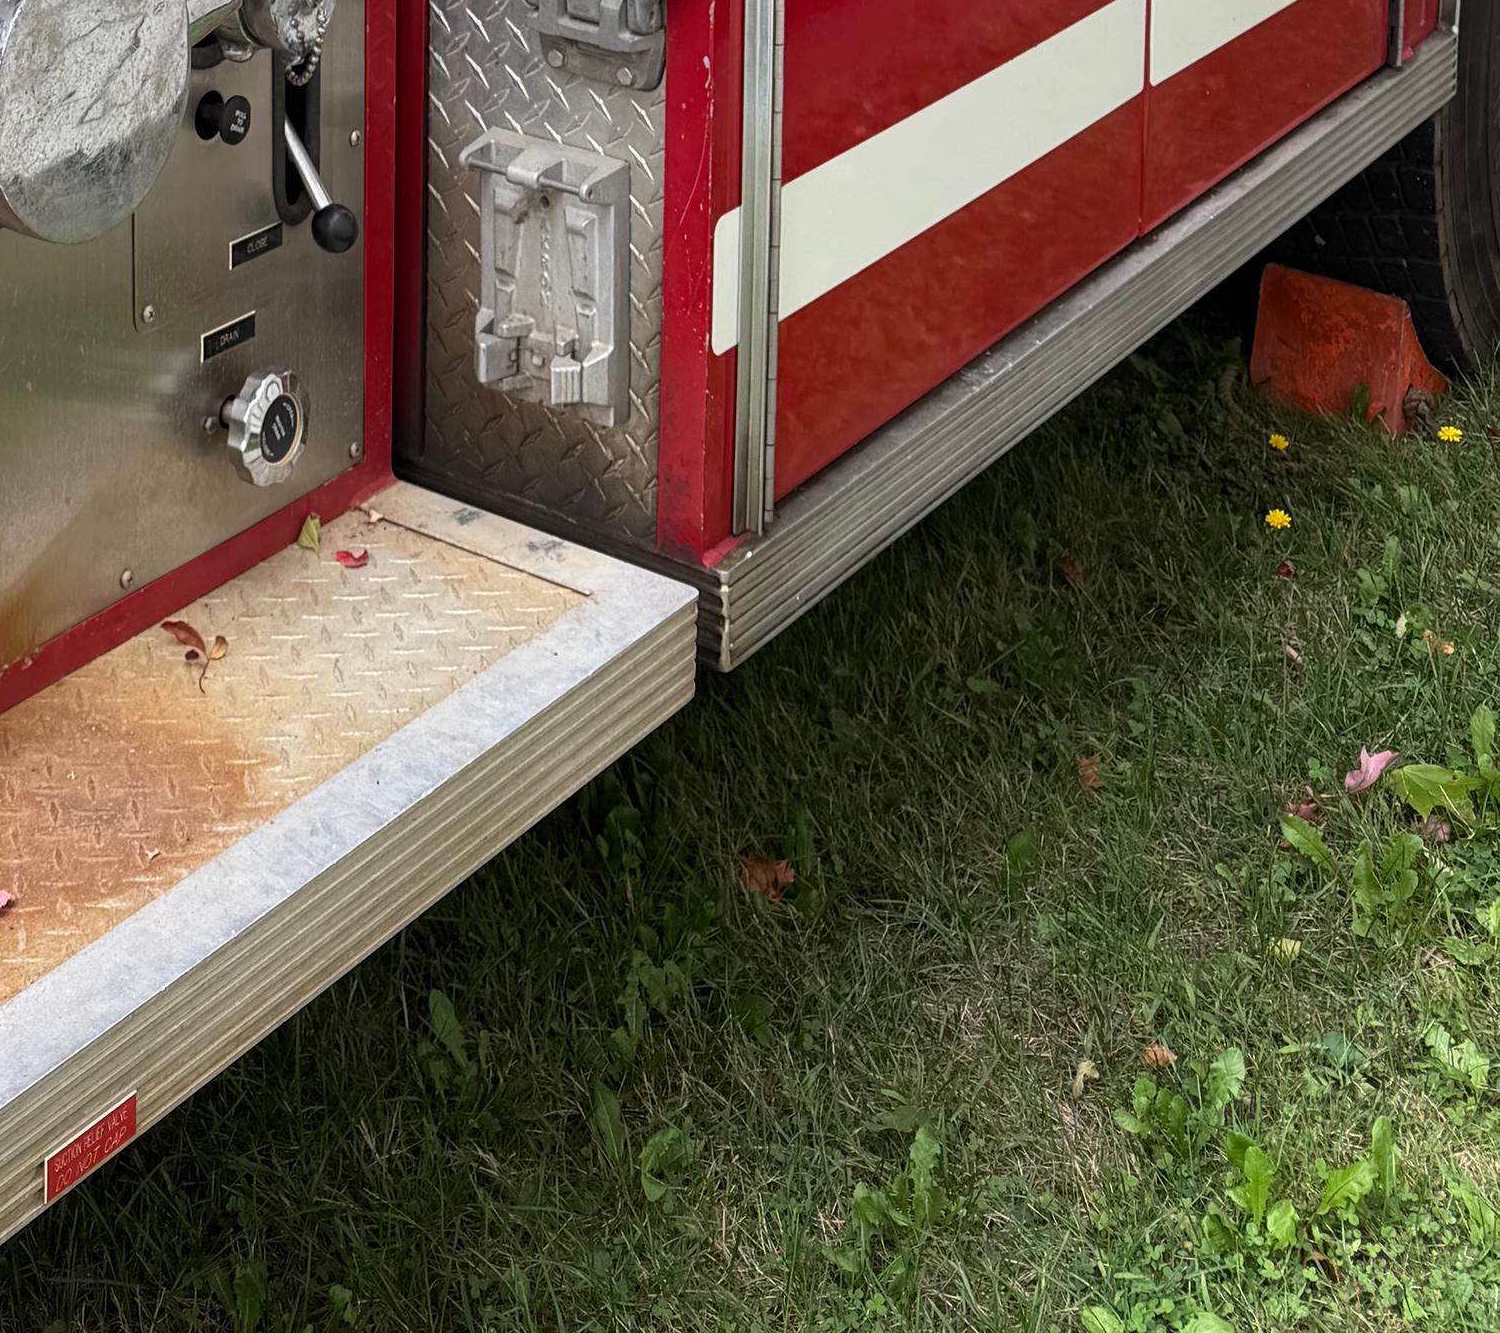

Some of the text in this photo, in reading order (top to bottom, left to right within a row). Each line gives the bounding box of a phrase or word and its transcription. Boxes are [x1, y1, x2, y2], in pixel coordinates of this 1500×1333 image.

[247, 236, 268, 254] CLOSE
[55, 1105, 128, 1172] SUCTION RELIEF VALVE
[56, 1126, 126, 1192] DO NOT CAP
